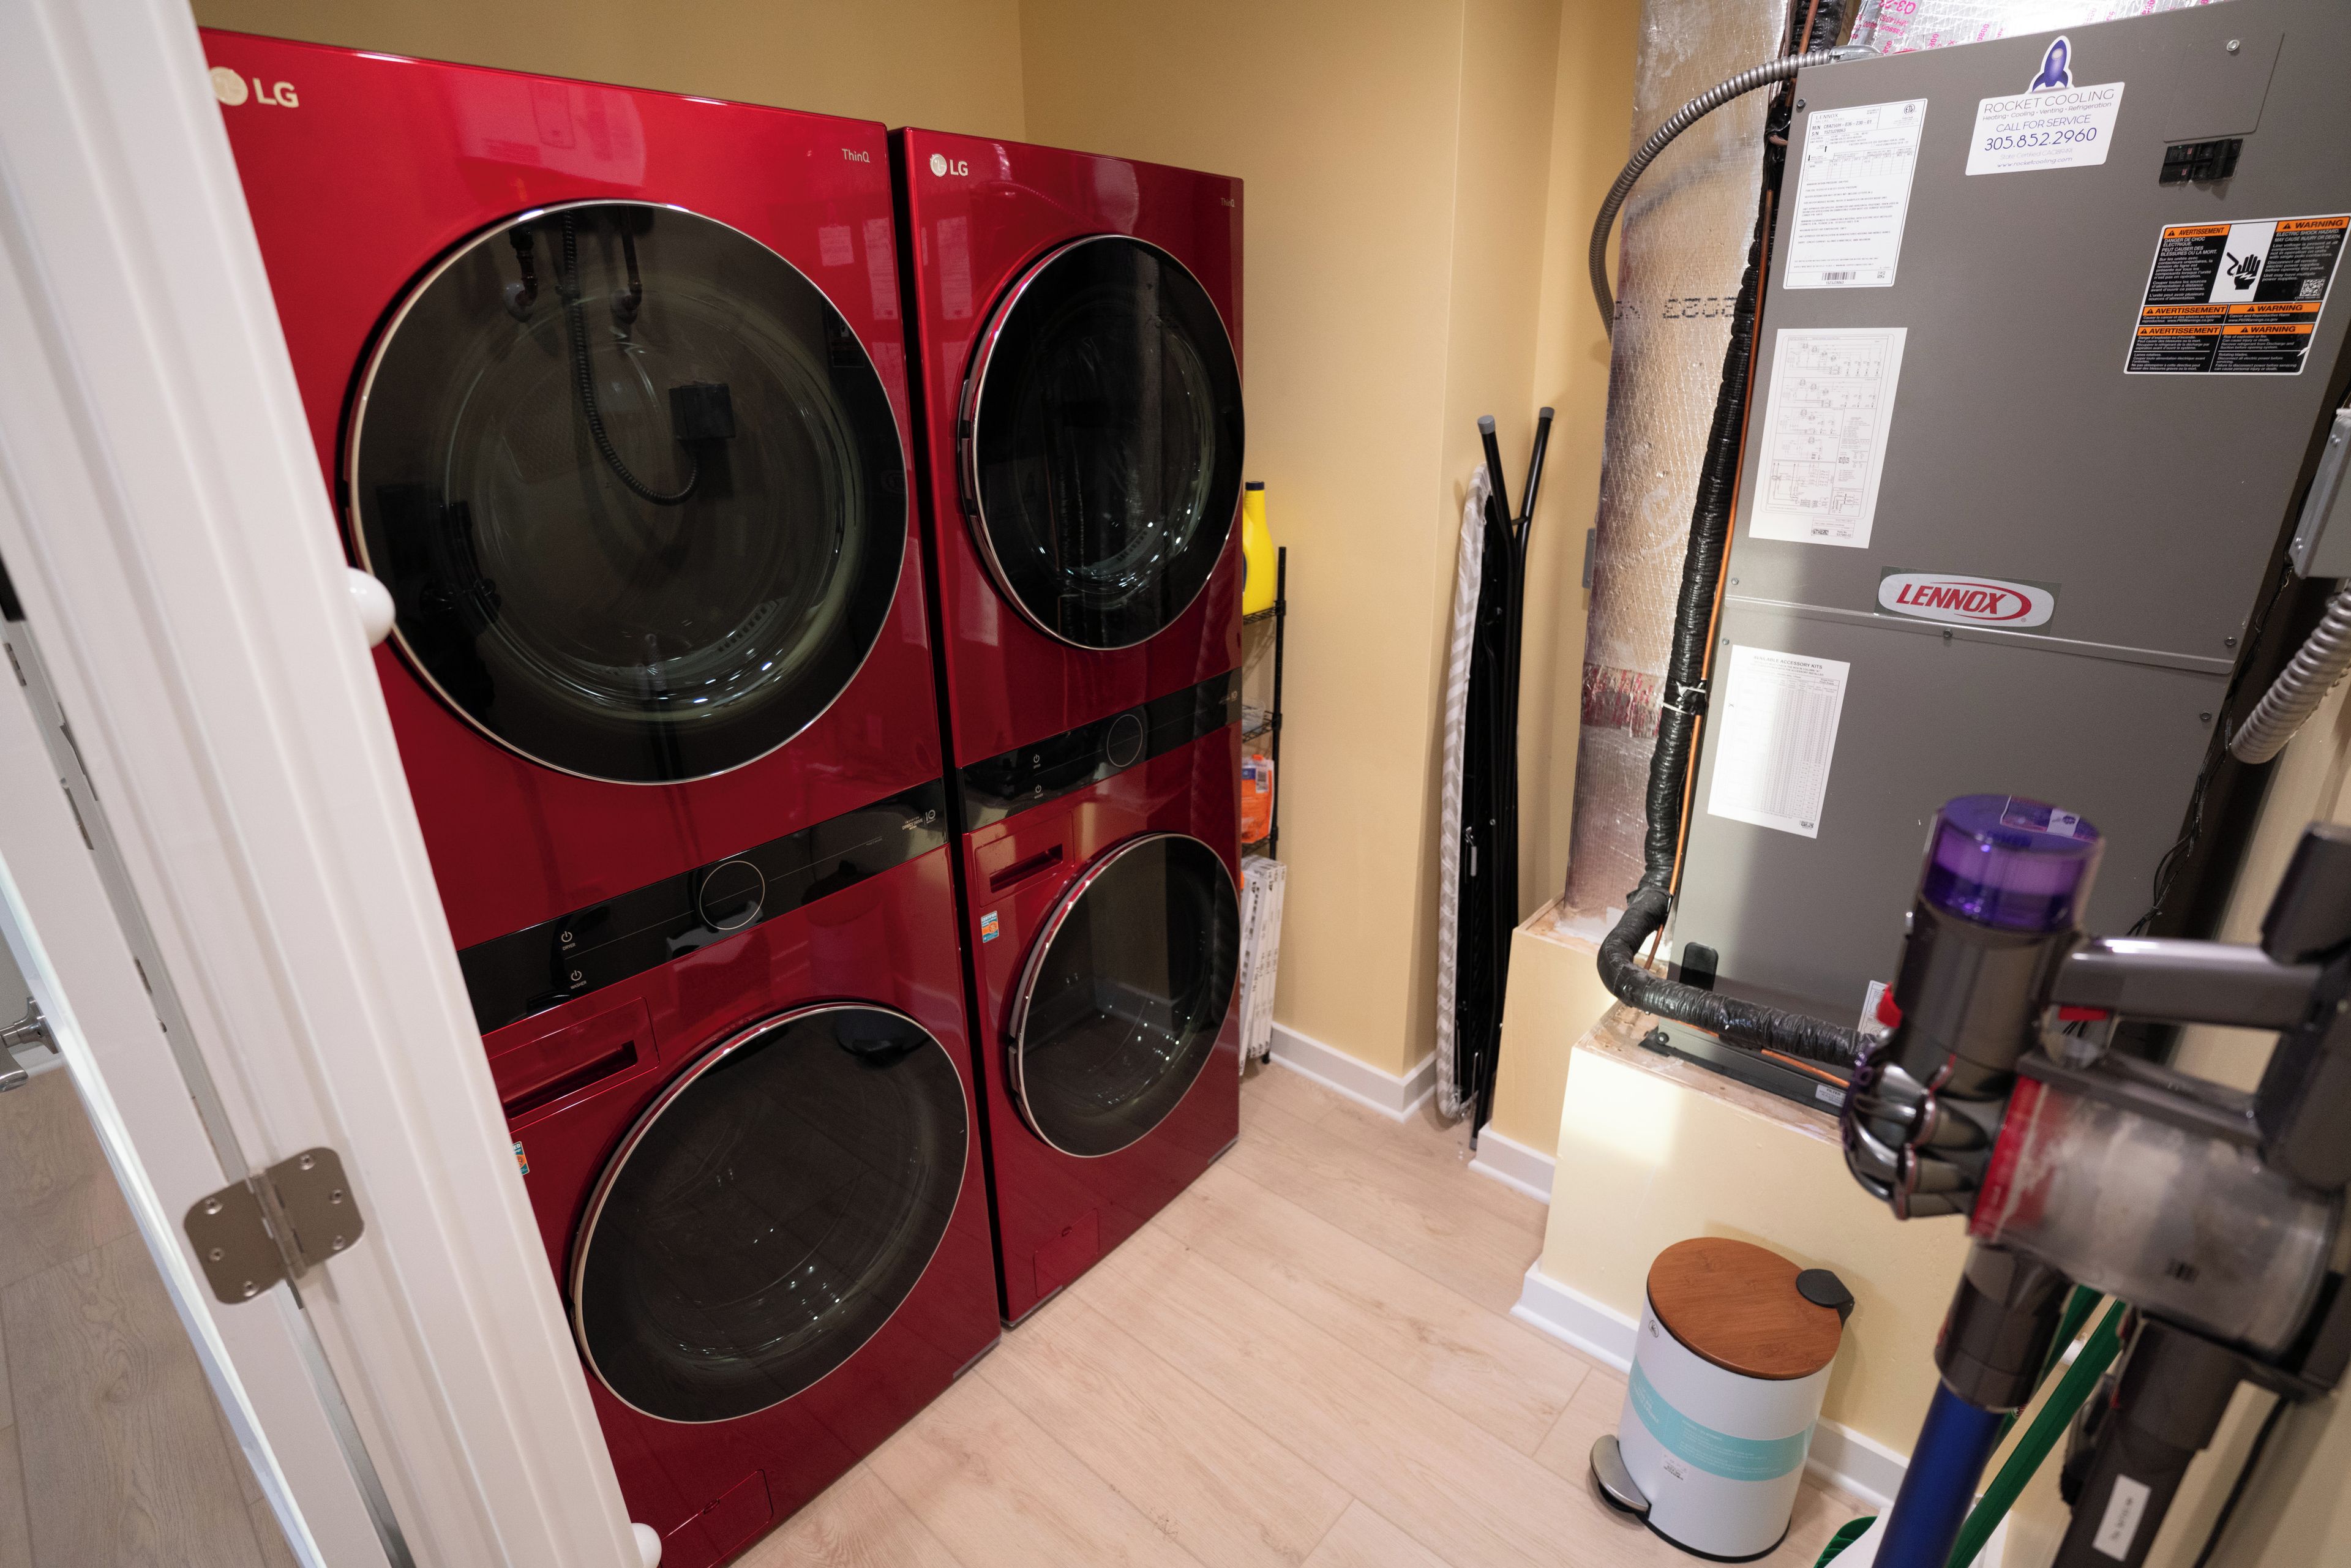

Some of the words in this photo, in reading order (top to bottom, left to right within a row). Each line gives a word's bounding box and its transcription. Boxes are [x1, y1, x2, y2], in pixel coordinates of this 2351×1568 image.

[1881, 24, 1905, 36] Fasson
[252, 78, 299, 108] LG
[1984, 98, 2041, 113] ROCKET
[2045, 89, 2115, 107] COOLING
[2069, 102, 2112, 111] Refrigeration
[1997, 124, 2020, 132] CALL
[2023, 120, 2044, 129] FOR
[2046, 114, 2091, 127] SERVICE
[1985, 127, 2097, 151] 305.852.2960
[842, 148, 870, 163] ThinQ
[1997, 157, 2072, 167] www.rocketcooling.com
[950, 160, 969, 176] LG
[2295, 219, 2344, 228] WARNING
[2179, 227, 2224, 236] AVERTISSEMENT
[1895, 583, 2007, 615] LENNOX
[570, 980, 587, 989] WASHER
